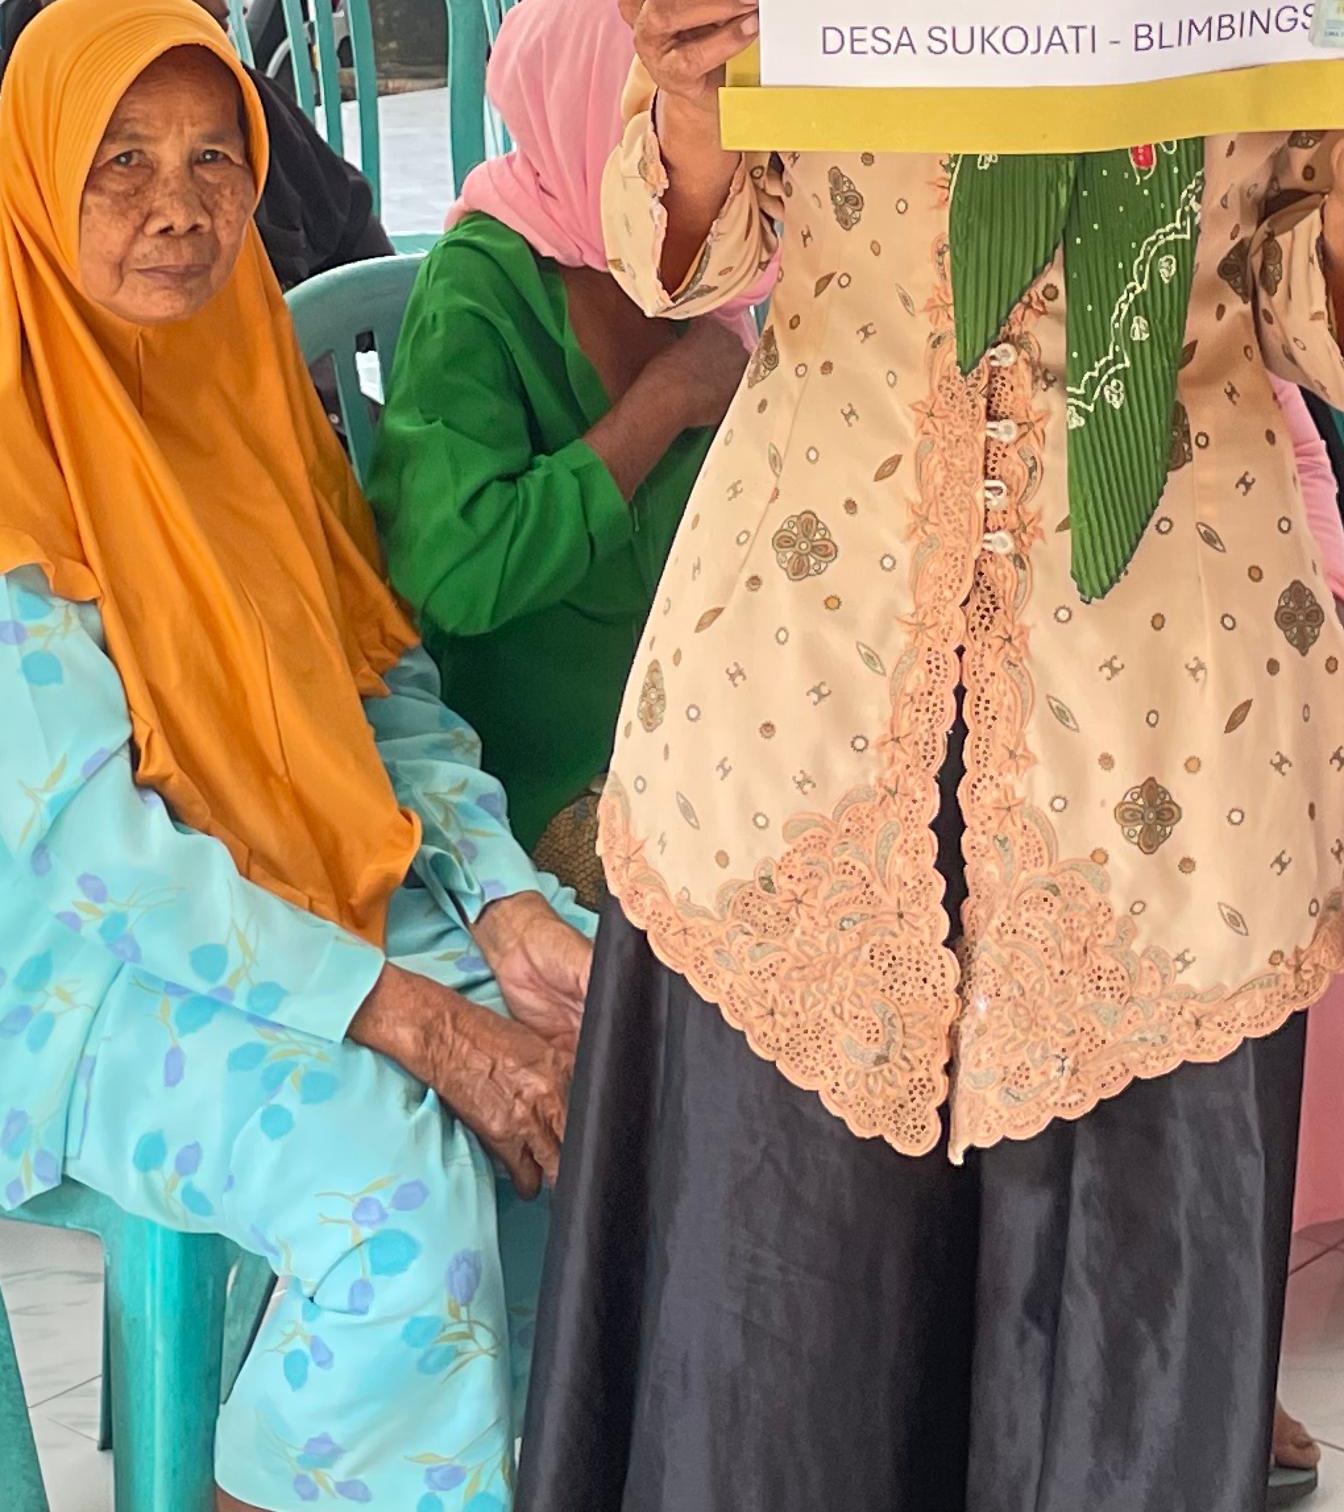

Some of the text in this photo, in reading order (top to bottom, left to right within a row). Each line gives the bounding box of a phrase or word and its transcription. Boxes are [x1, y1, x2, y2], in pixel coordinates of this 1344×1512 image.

[822, 26, 916, 55] DESA
[927, 25, 1096, 55] SUKOJATI
[1134, 2, 1316, 52] BLIMBINGS
